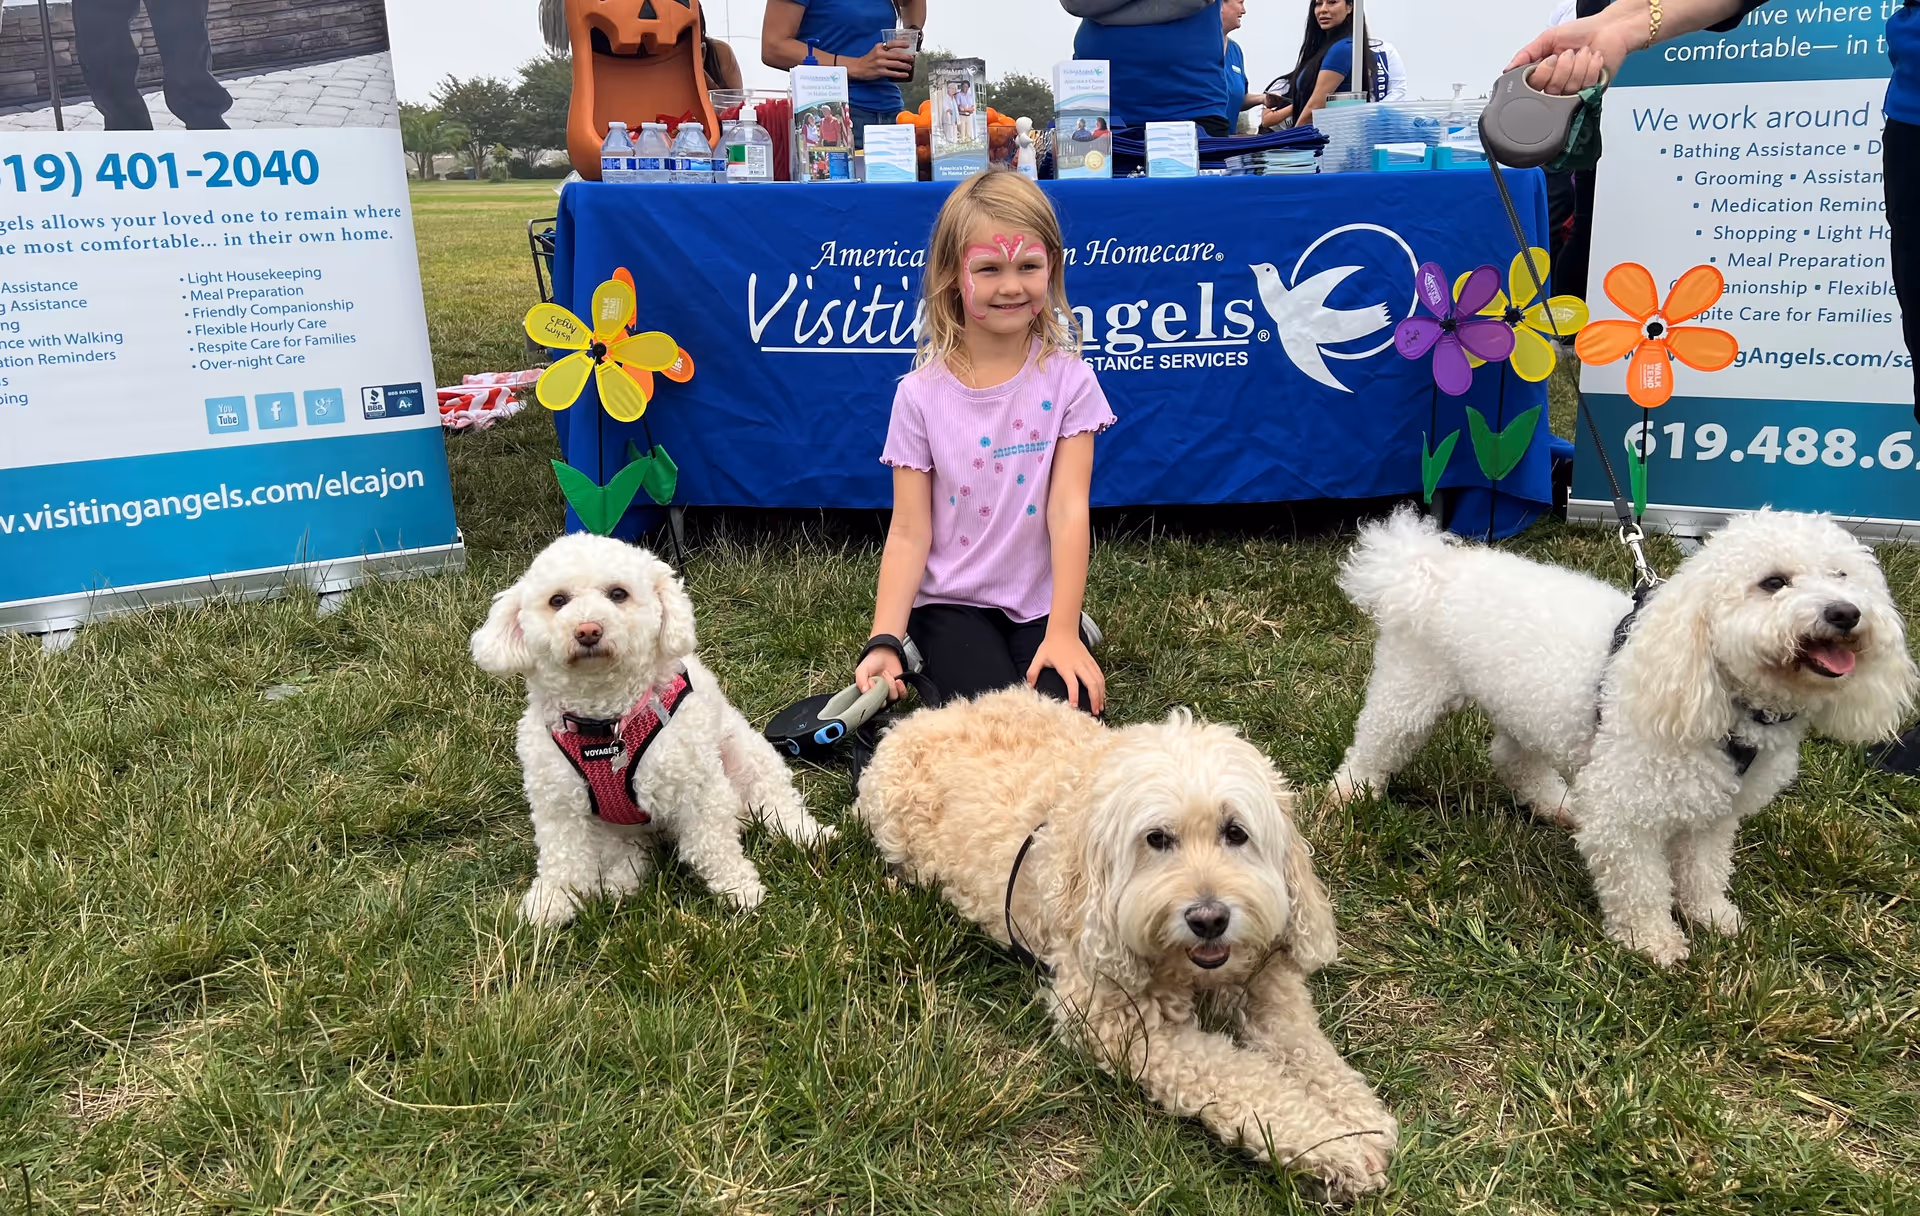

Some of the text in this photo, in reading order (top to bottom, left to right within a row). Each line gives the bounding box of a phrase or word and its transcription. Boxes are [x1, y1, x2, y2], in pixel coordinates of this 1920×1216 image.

[1746, 5, 1788, 26] live
[1797, 3, 1872, 24] where
[1846, 34, 1868, 55] in
[1632, 107, 1678, 132] We
[1688, 104, 1757, 130] work
[1766, 101, 1870, 128] around
[1673, 142, 1846, 160] Bathing Assistance
[0, 149, 319, 197] 19) 401-2040
[1694, 170, 1783, 187] Grooming
[1711, 197, 1813, 212] Medication
[41, 214, 105, 230] allows
[111, 215, 156, 231] your
[162, 210, 215, 226] loved
[221, 212, 254, 224] one
[260, 209, 278, 222] to
[285, 206, 348, 221] remain
[353, 204, 401, 218] where
[24, 240, 73, 254] most
[224, 233, 242, 246] in
[249, 230, 293, 245] their
[299, 231, 336, 243] own
[341, 227, 393, 241] home.
[1713, 225, 1797, 243] Shopping
[1817, 224, 1862, 243] Light
[1727, 252, 1885, 270] Meal Preparation
[187, 267, 322, 286] Light Housekeeping
[1, 281, 78, 294] Assistance
[190, 285, 304, 301] Meal Preparation
[1828, 280, 1897, 296] Flexible
[11, 299, 87, 312] Assistance
[192, 299, 354, 319] Friendly Companionship
[1739, 307, 1781, 321] Care
[1786, 307, 1812, 322] for
[1817, 307, 1892, 323] Families
[195, 318, 327, 336] Flexible Hourly Care
[28, 335, 61, 348] with
[64, 332, 123, 346] Walking
[197, 333, 356, 354] Respite Care for Families
[38, 350, 116, 365] Reminders
[200, 353, 305, 371] Over-night Care
[1083, 351, 1248, 371] STANCE SERVICES
[1653, 362, 1662, 388] WALK
[218, 415, 238, 426] Tube
[1624, 420, 1920, 471] 619.488.6
